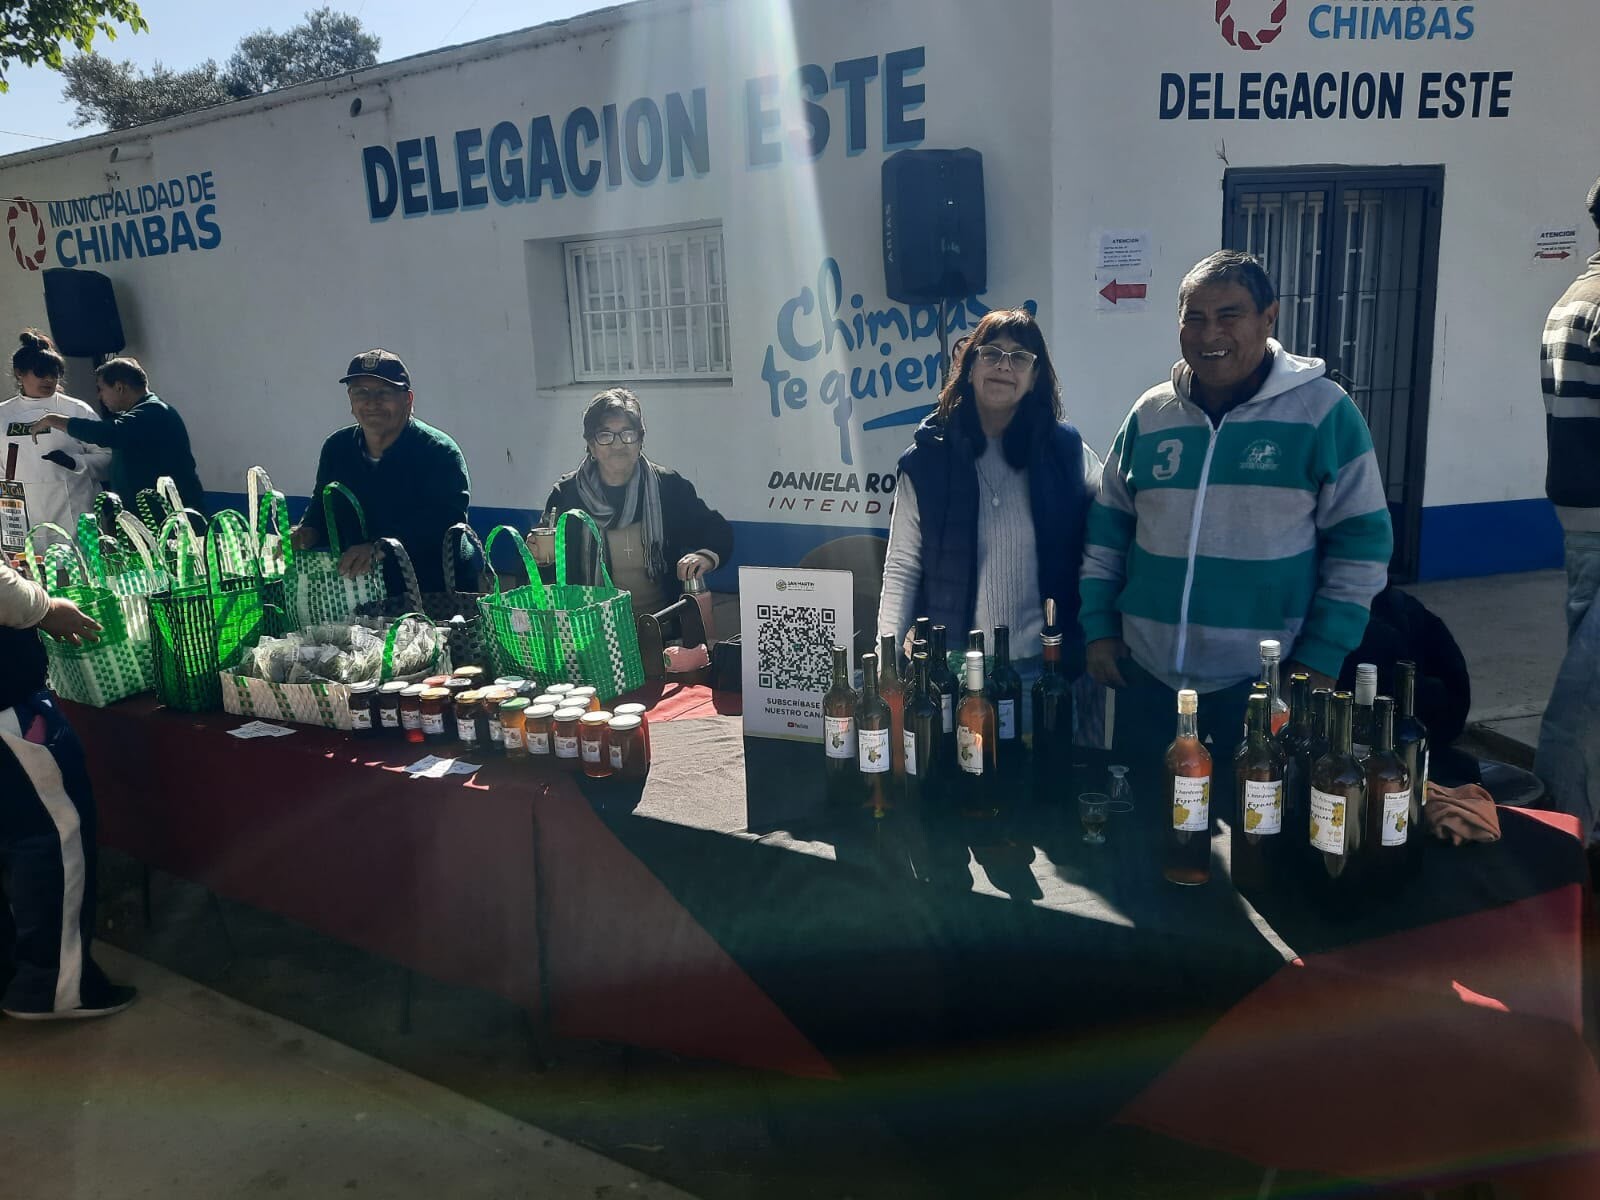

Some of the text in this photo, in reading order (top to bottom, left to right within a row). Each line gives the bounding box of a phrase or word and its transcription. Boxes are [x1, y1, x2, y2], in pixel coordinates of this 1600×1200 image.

[1308, 4, 1474, 40] CHIMBAS
[1159, 71, 1514, 120] DELEGACION ESTE
[362, 46, 927, 221] DELEGACION ESTE
[48, 171, 216, 228] MUNICIPALIDAD DE
[56, 203, 222, 267] CHIMBAS
[761, 344, 808, 418] te
[768, 471, 860, 493] DANIELA
[1152, 439, 1183, 480] 3
[764, 706, 802, 717] NUESTRO
[766, 697, 821, 709] SUBSCRÍBASE
